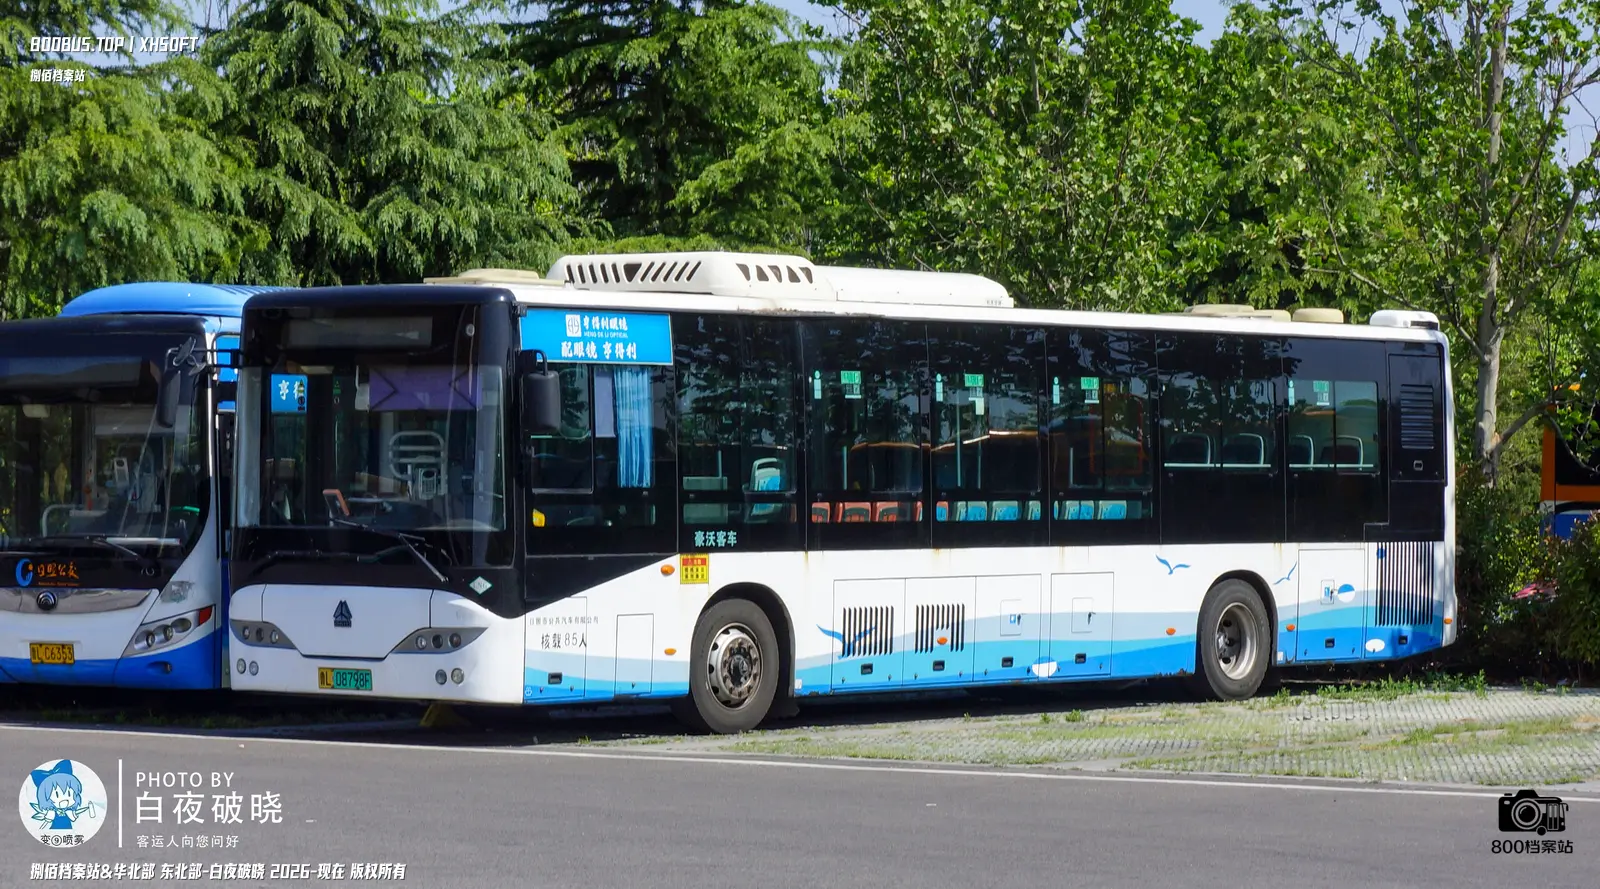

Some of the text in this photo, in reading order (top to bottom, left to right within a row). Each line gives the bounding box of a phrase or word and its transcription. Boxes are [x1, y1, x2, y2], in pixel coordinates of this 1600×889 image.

[561, 341, 636, 360] 配眼镜 亨得利
[694, 530, 738, 547] 豪沃客车
[541, 632, 587, 649] 核载85人
